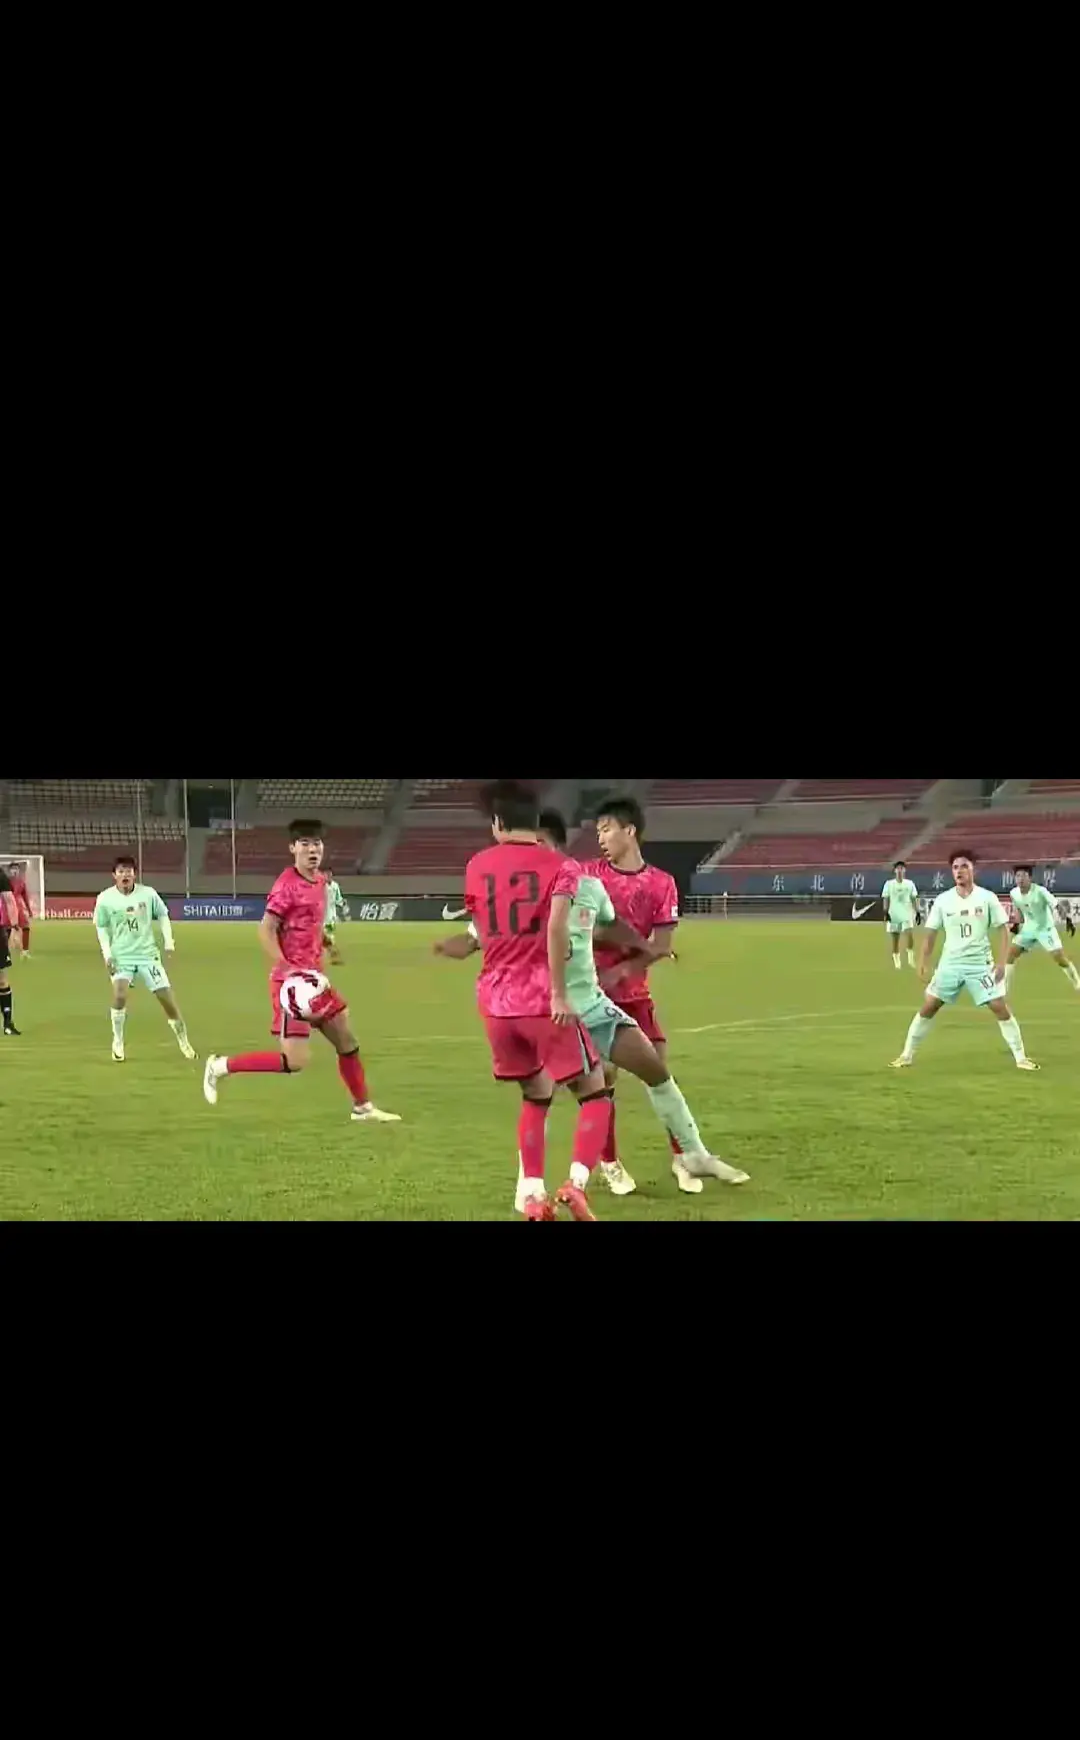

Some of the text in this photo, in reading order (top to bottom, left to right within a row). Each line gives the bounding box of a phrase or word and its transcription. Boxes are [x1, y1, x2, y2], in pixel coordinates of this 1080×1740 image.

[482, 871, 541, 937] 12
[127, 918, 138, 932] 14
[960, 923, 972, 938] 10
[148, 966, 162, 979] 14
[979, 975, 994, 989] 10
